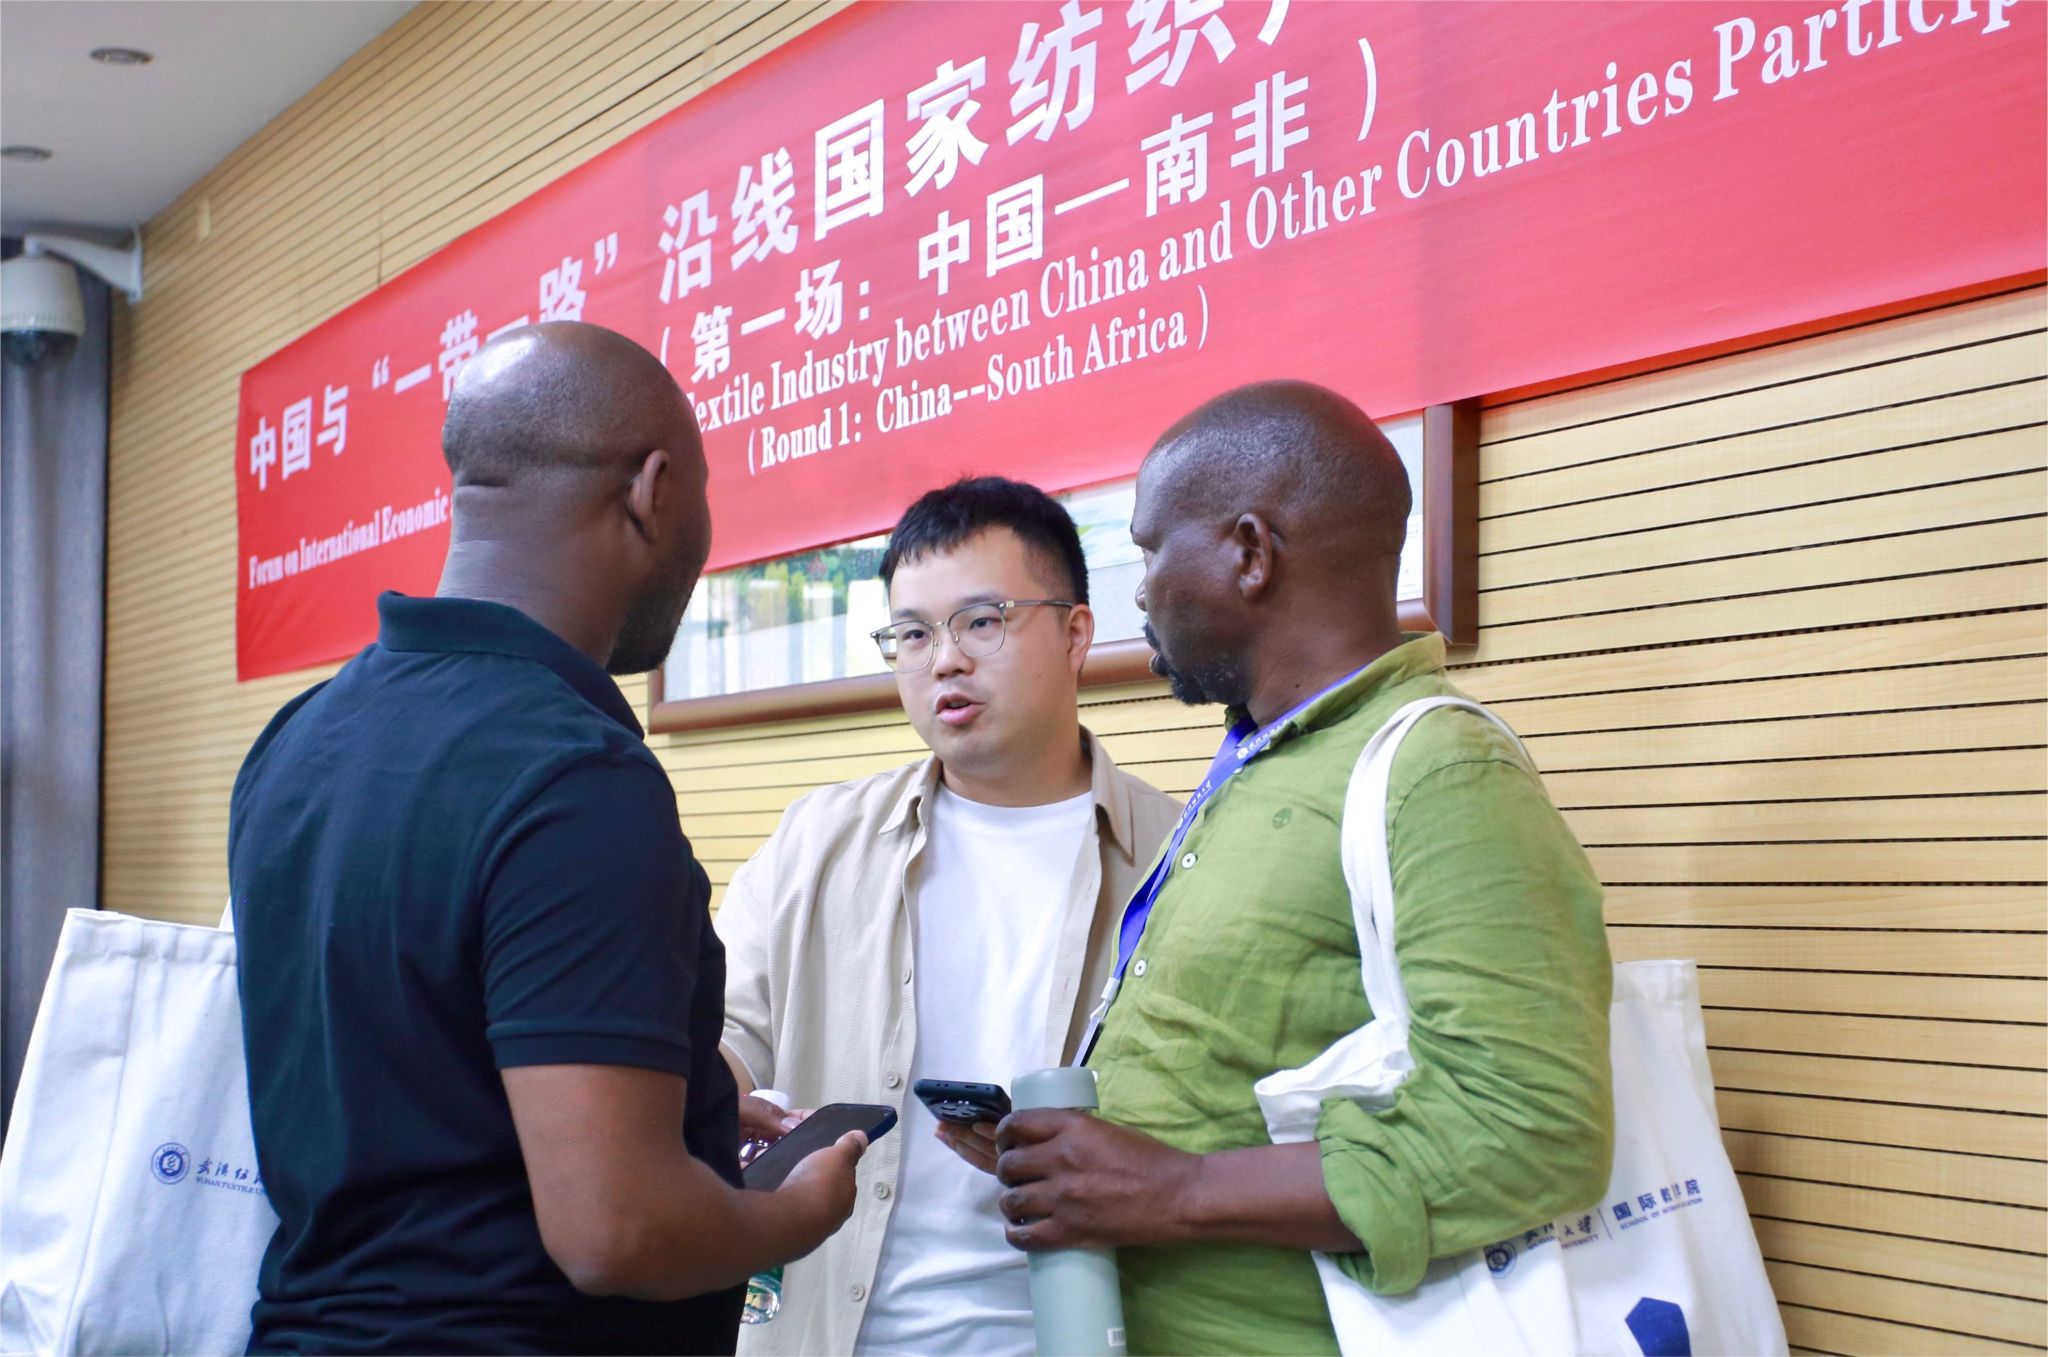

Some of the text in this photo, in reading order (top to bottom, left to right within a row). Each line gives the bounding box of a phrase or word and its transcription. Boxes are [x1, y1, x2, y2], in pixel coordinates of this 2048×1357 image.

[249, 555, 284, 590] Forum
[284, 550, 299, 577] on
[299, 510, 380, 573] International
[381, 487, 449, 544] Economic
[769, 338, 890, 410] Industry
[894, 289, 1032, 370] between
[1040, 246, 1150, 318] China
[1158, 200, 1235, 282] and
[1245, 164, 1383, 250] Other
[1396, 58, 1694, 199] Countries
